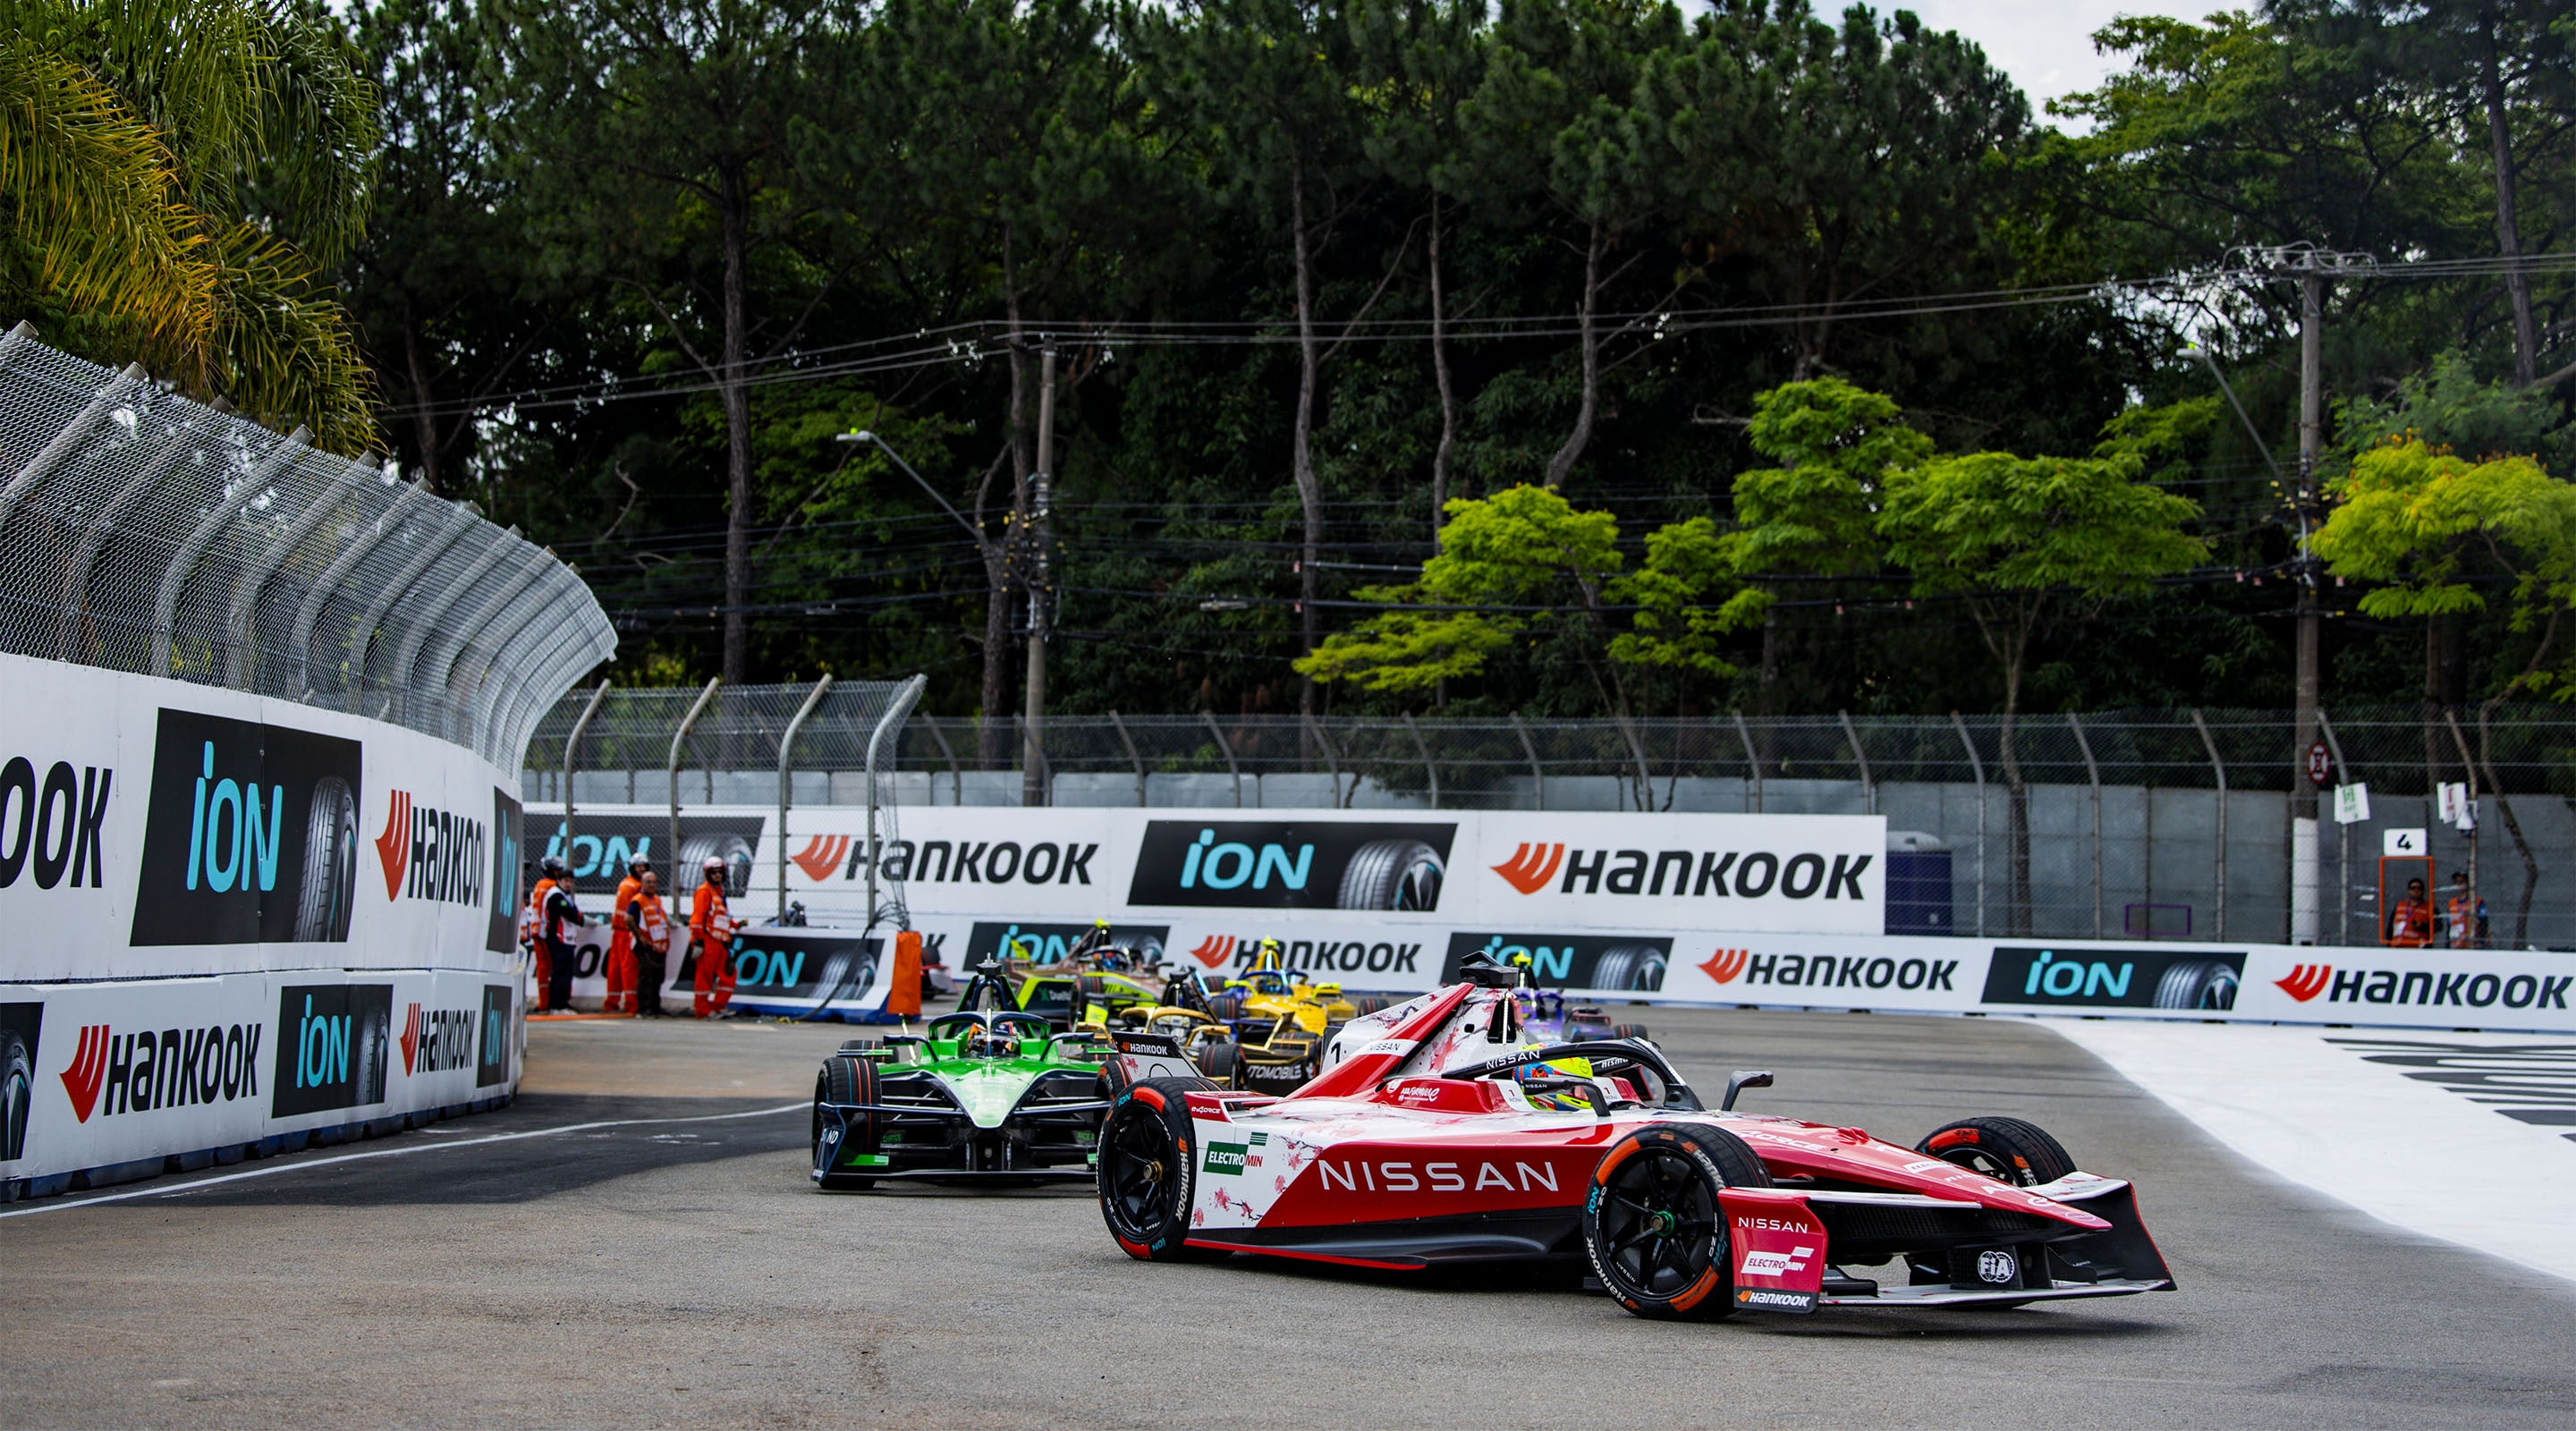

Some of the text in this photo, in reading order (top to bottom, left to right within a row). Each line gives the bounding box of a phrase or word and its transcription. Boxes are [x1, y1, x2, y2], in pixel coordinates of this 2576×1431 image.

[1181, 828, 1315, 891] iON
[2397, 834, 2412, 850] 4
[1561, 849, 1874, 900] HanKOOK
[1746, 953, 1960, 991] HanKOOK
[2024, 950, 2133, 998] iON
[2329, 969, 2574, 1010] HanKOOK
[296, 994, 352, 1088] iON
[1486, 1050, 1540, 1070] NISSAN
[104, 1022, 262, 1117] HanKOOK
[1318, 1159, 1560, 1193] NISSAN
[1738, 1216, 1808, 1233] NISSAN
